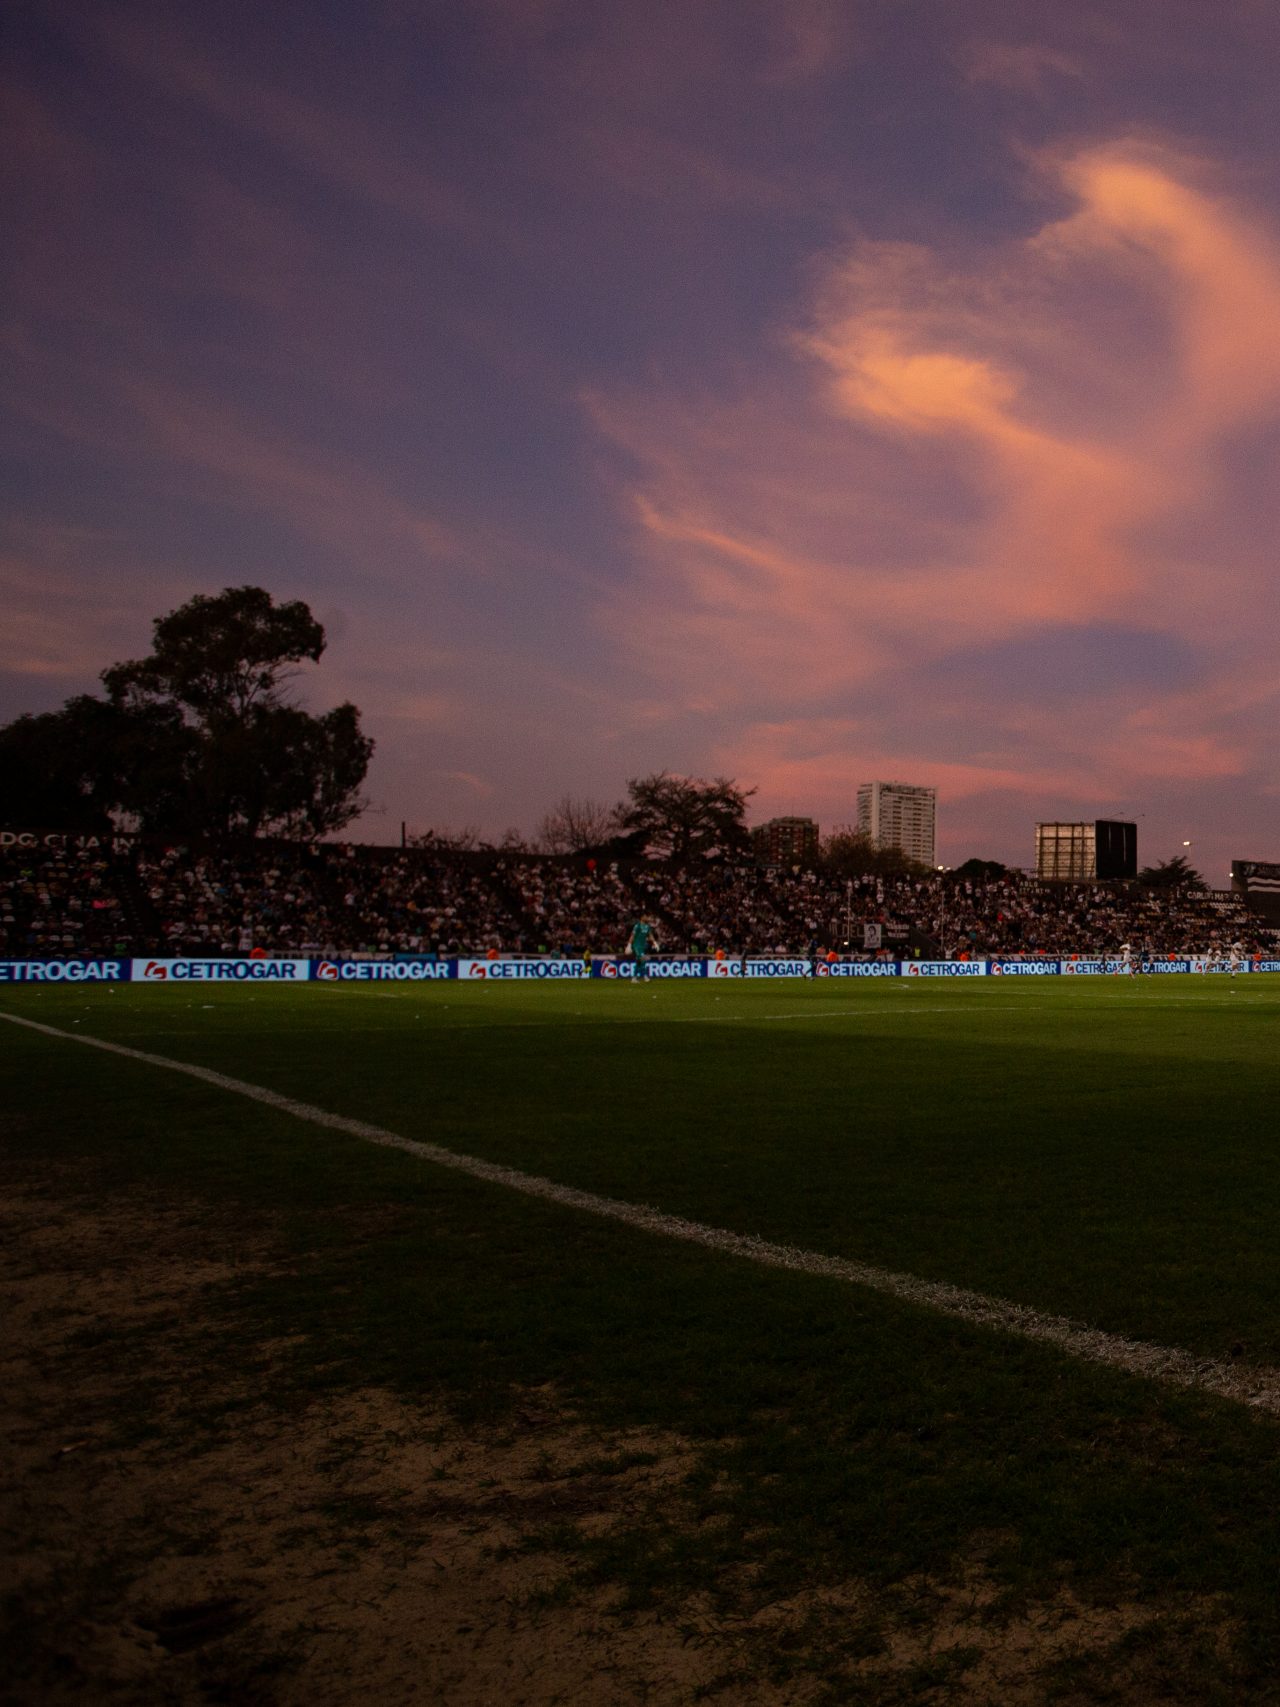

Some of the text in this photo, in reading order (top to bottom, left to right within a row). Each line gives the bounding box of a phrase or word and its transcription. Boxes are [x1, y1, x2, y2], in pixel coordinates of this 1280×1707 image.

[171, 962, 297, 979] CETROGAR
[341, 962, 450, 980] CETROGAR
[489, 963, 583, 978] CETROGAR
[831, 962, 897, 977] CETROGAR
[921, 963, 980, 976] CETROGAR
[1003, 962, 1058, 975] CETROGAR
